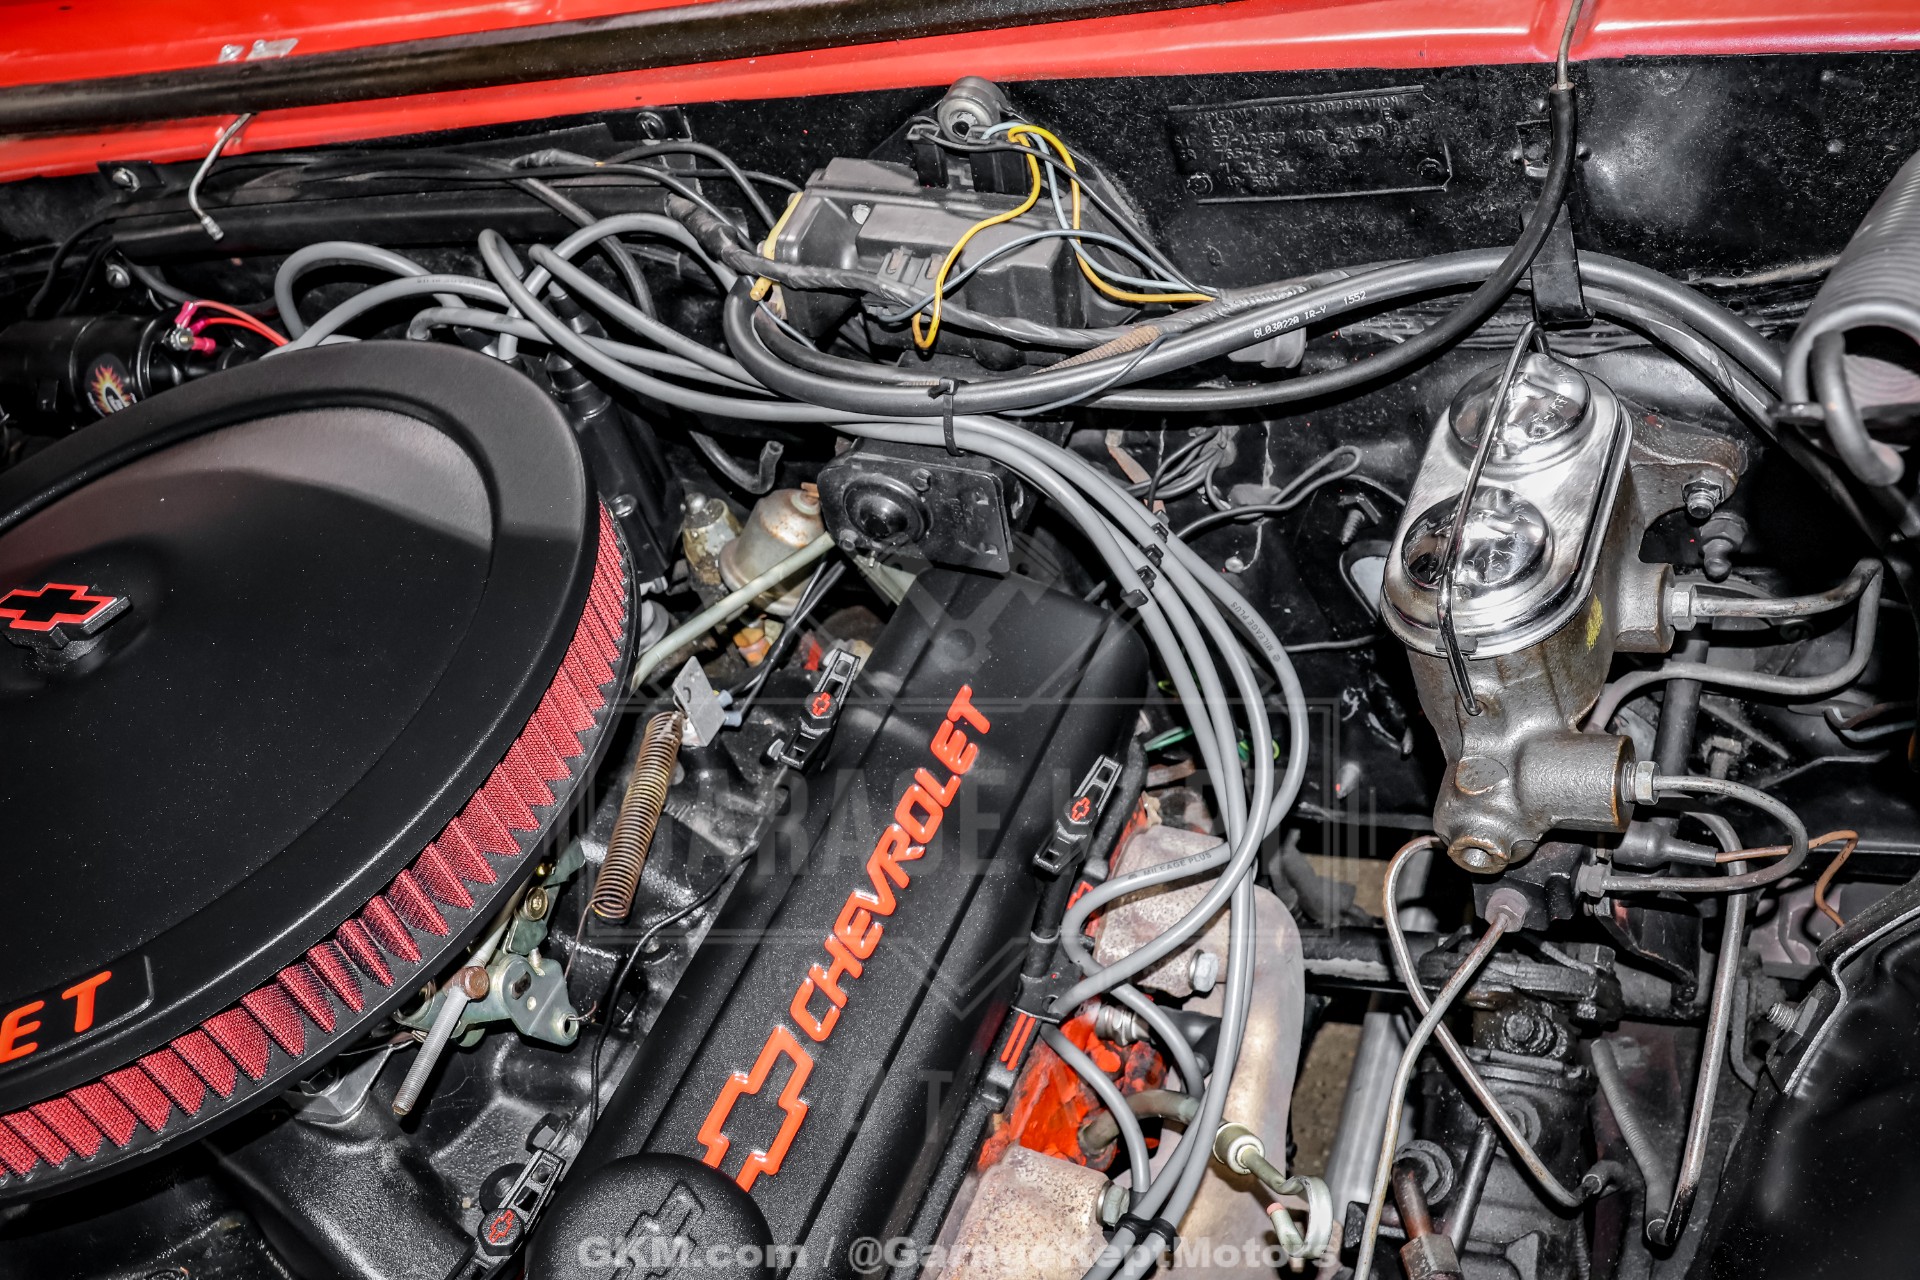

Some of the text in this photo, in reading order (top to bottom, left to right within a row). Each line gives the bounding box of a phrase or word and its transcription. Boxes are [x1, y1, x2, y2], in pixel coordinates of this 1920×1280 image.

[1304, 304, 1327, 320] IR-Y
[1343, 290, 1367, 306] 1552
[1230, 601, 1275, 652] MILEAGE PLUS
[789, 684, 991, 1042] CHEVROLET
[1143, 852, 1212, 876] MILEAGE PLUS
